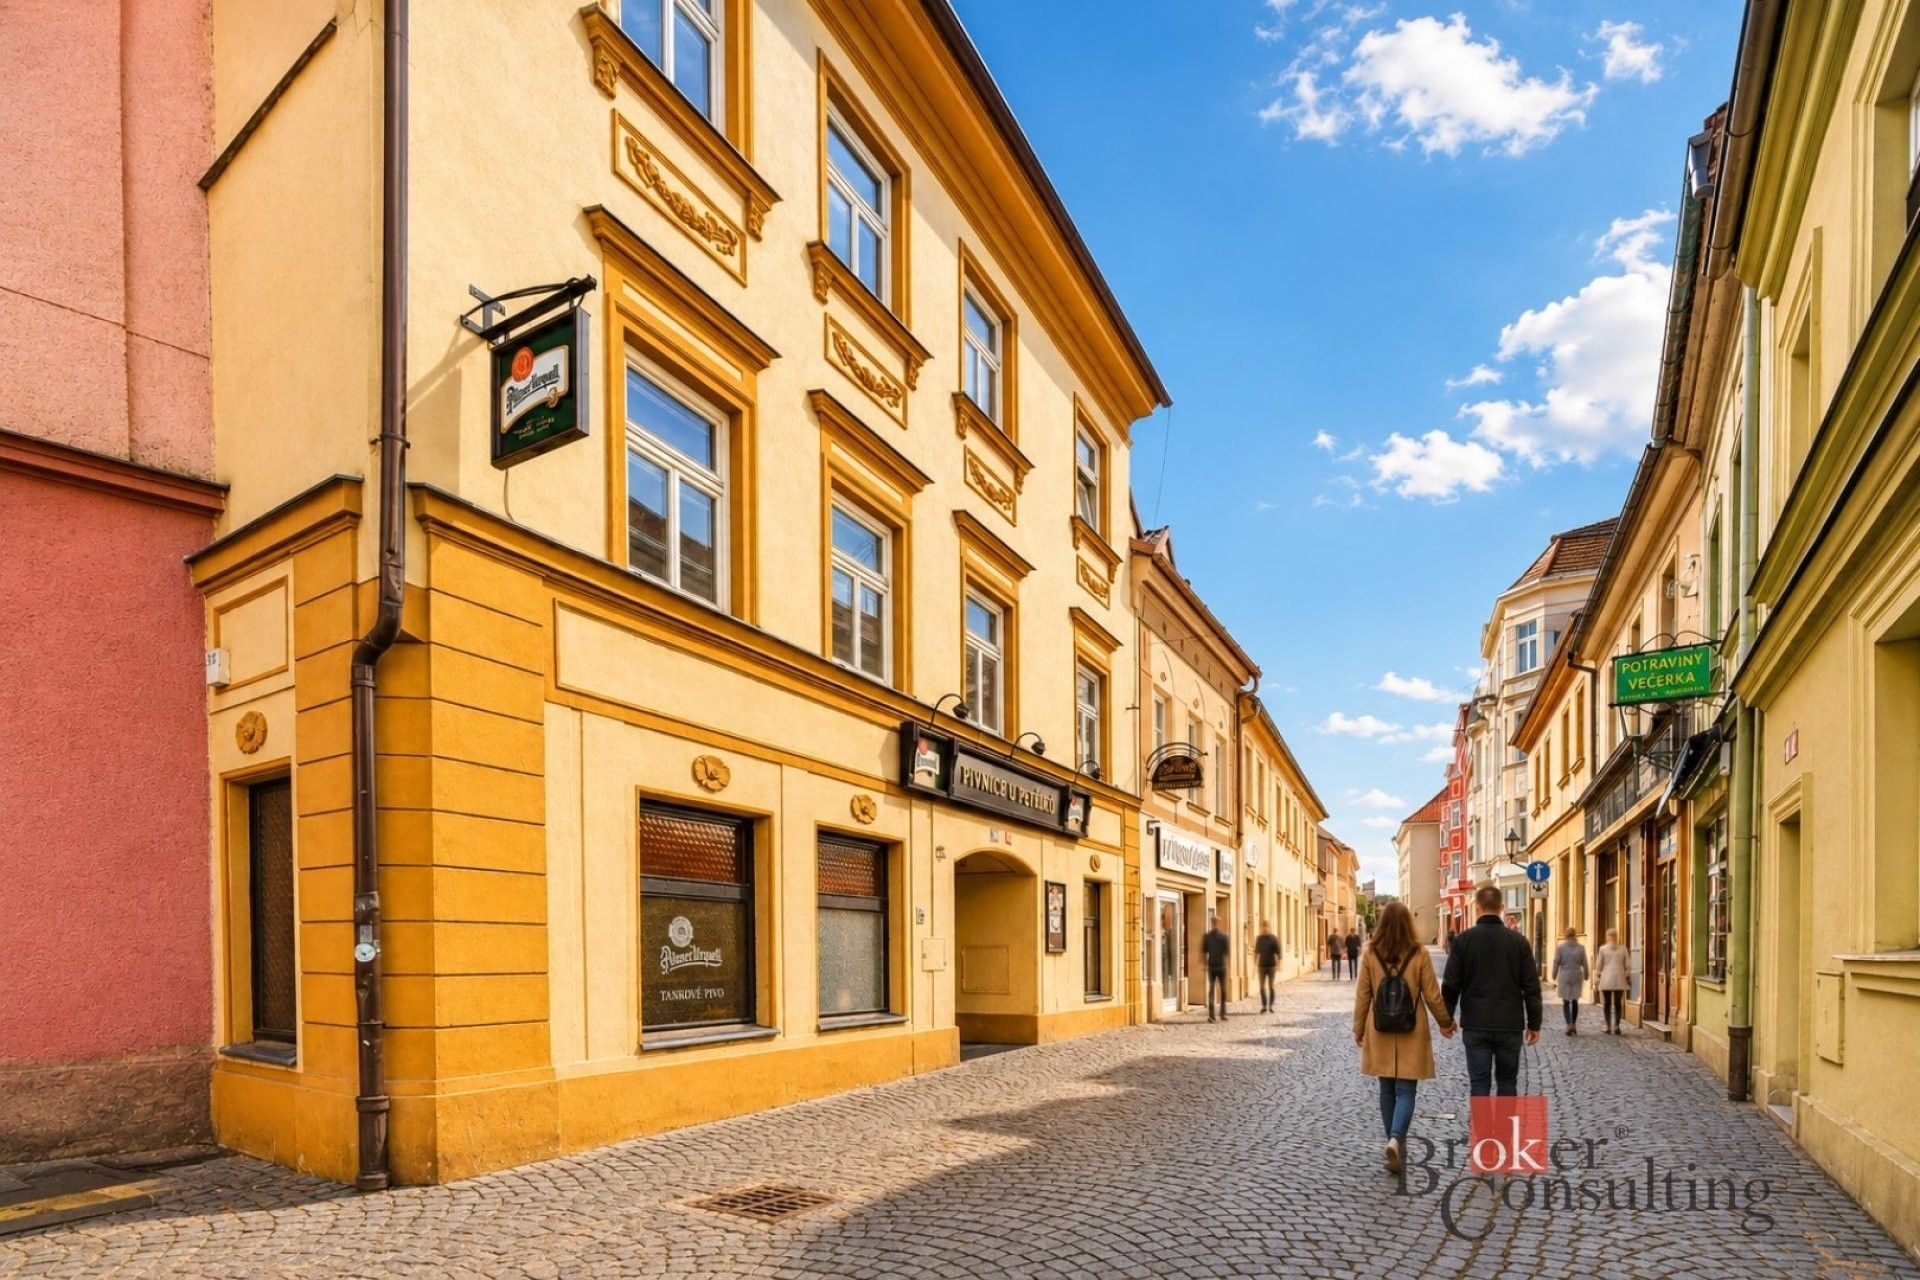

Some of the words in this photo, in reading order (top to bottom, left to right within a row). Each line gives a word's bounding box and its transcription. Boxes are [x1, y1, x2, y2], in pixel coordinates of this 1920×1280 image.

[1622, 653, 1704, 674] POTRAVINY
[1628, 672, 1696, 690] VEČERKA
[1008, 783, 1017, 801] U
